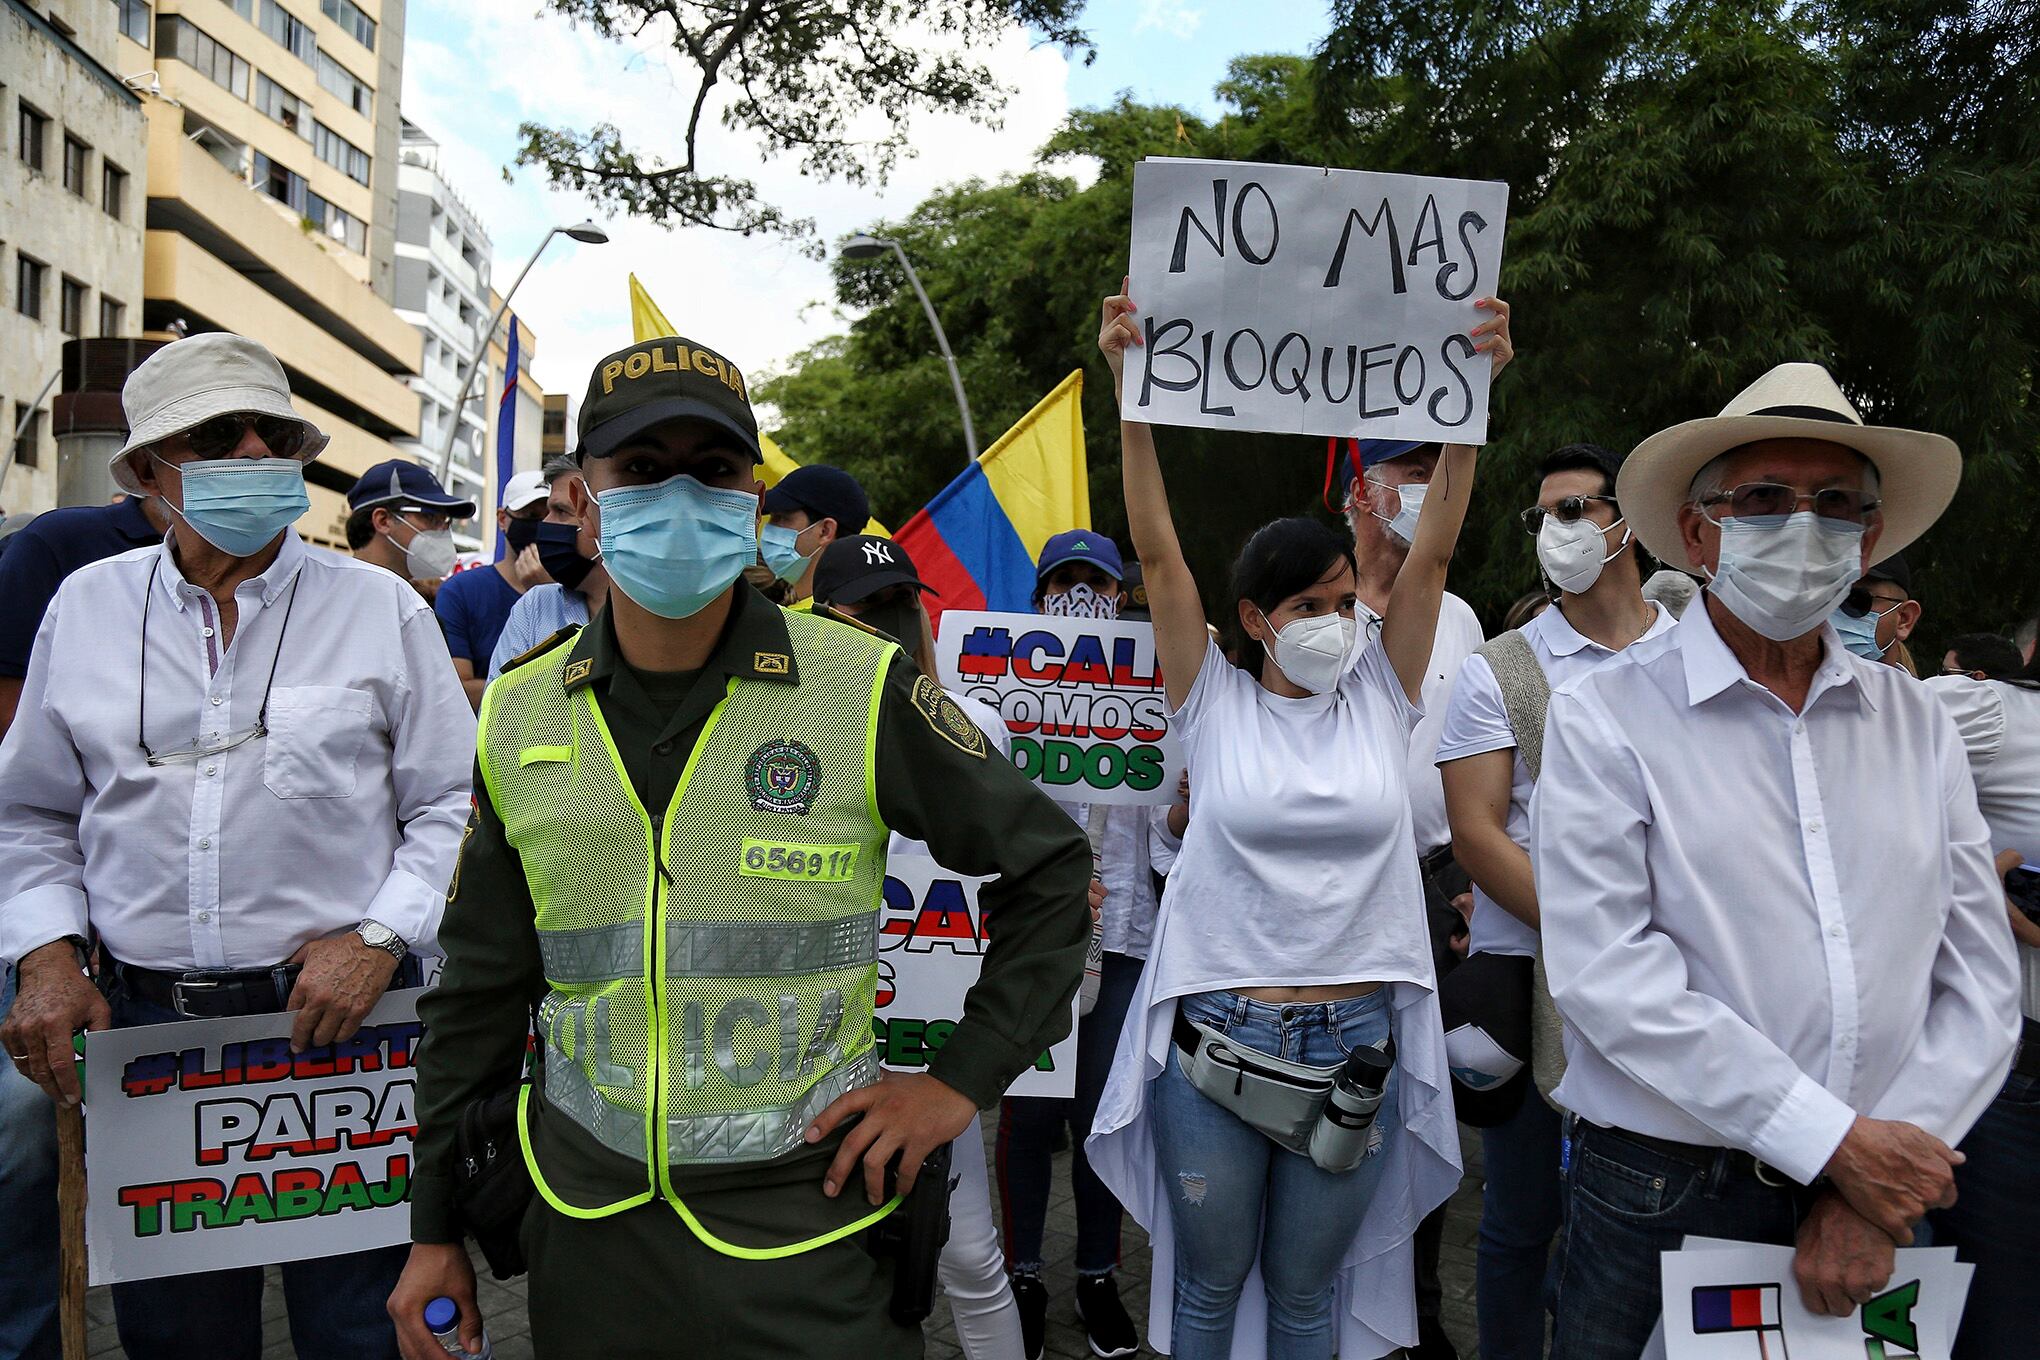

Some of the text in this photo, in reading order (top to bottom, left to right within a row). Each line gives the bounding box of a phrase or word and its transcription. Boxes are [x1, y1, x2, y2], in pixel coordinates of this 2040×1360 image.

[1169, 178, 1488, 301] NO MAS
[602, 345, 745, 401] POLICIA
[1137, 316, 1478, 427] BLOQUEOS
[861, 541, 895, 565] NY
[1010, 736, 1165, 791] ODOS
[745, 846, 852, 877] 656911
[121, 1020, 417, 1098] #LIBERT
[540, 988, 846, 1090] OLICIA
[196, 1078, 418, 1167] PARA
[118, 1153, 414, 1238] TRABAJ
